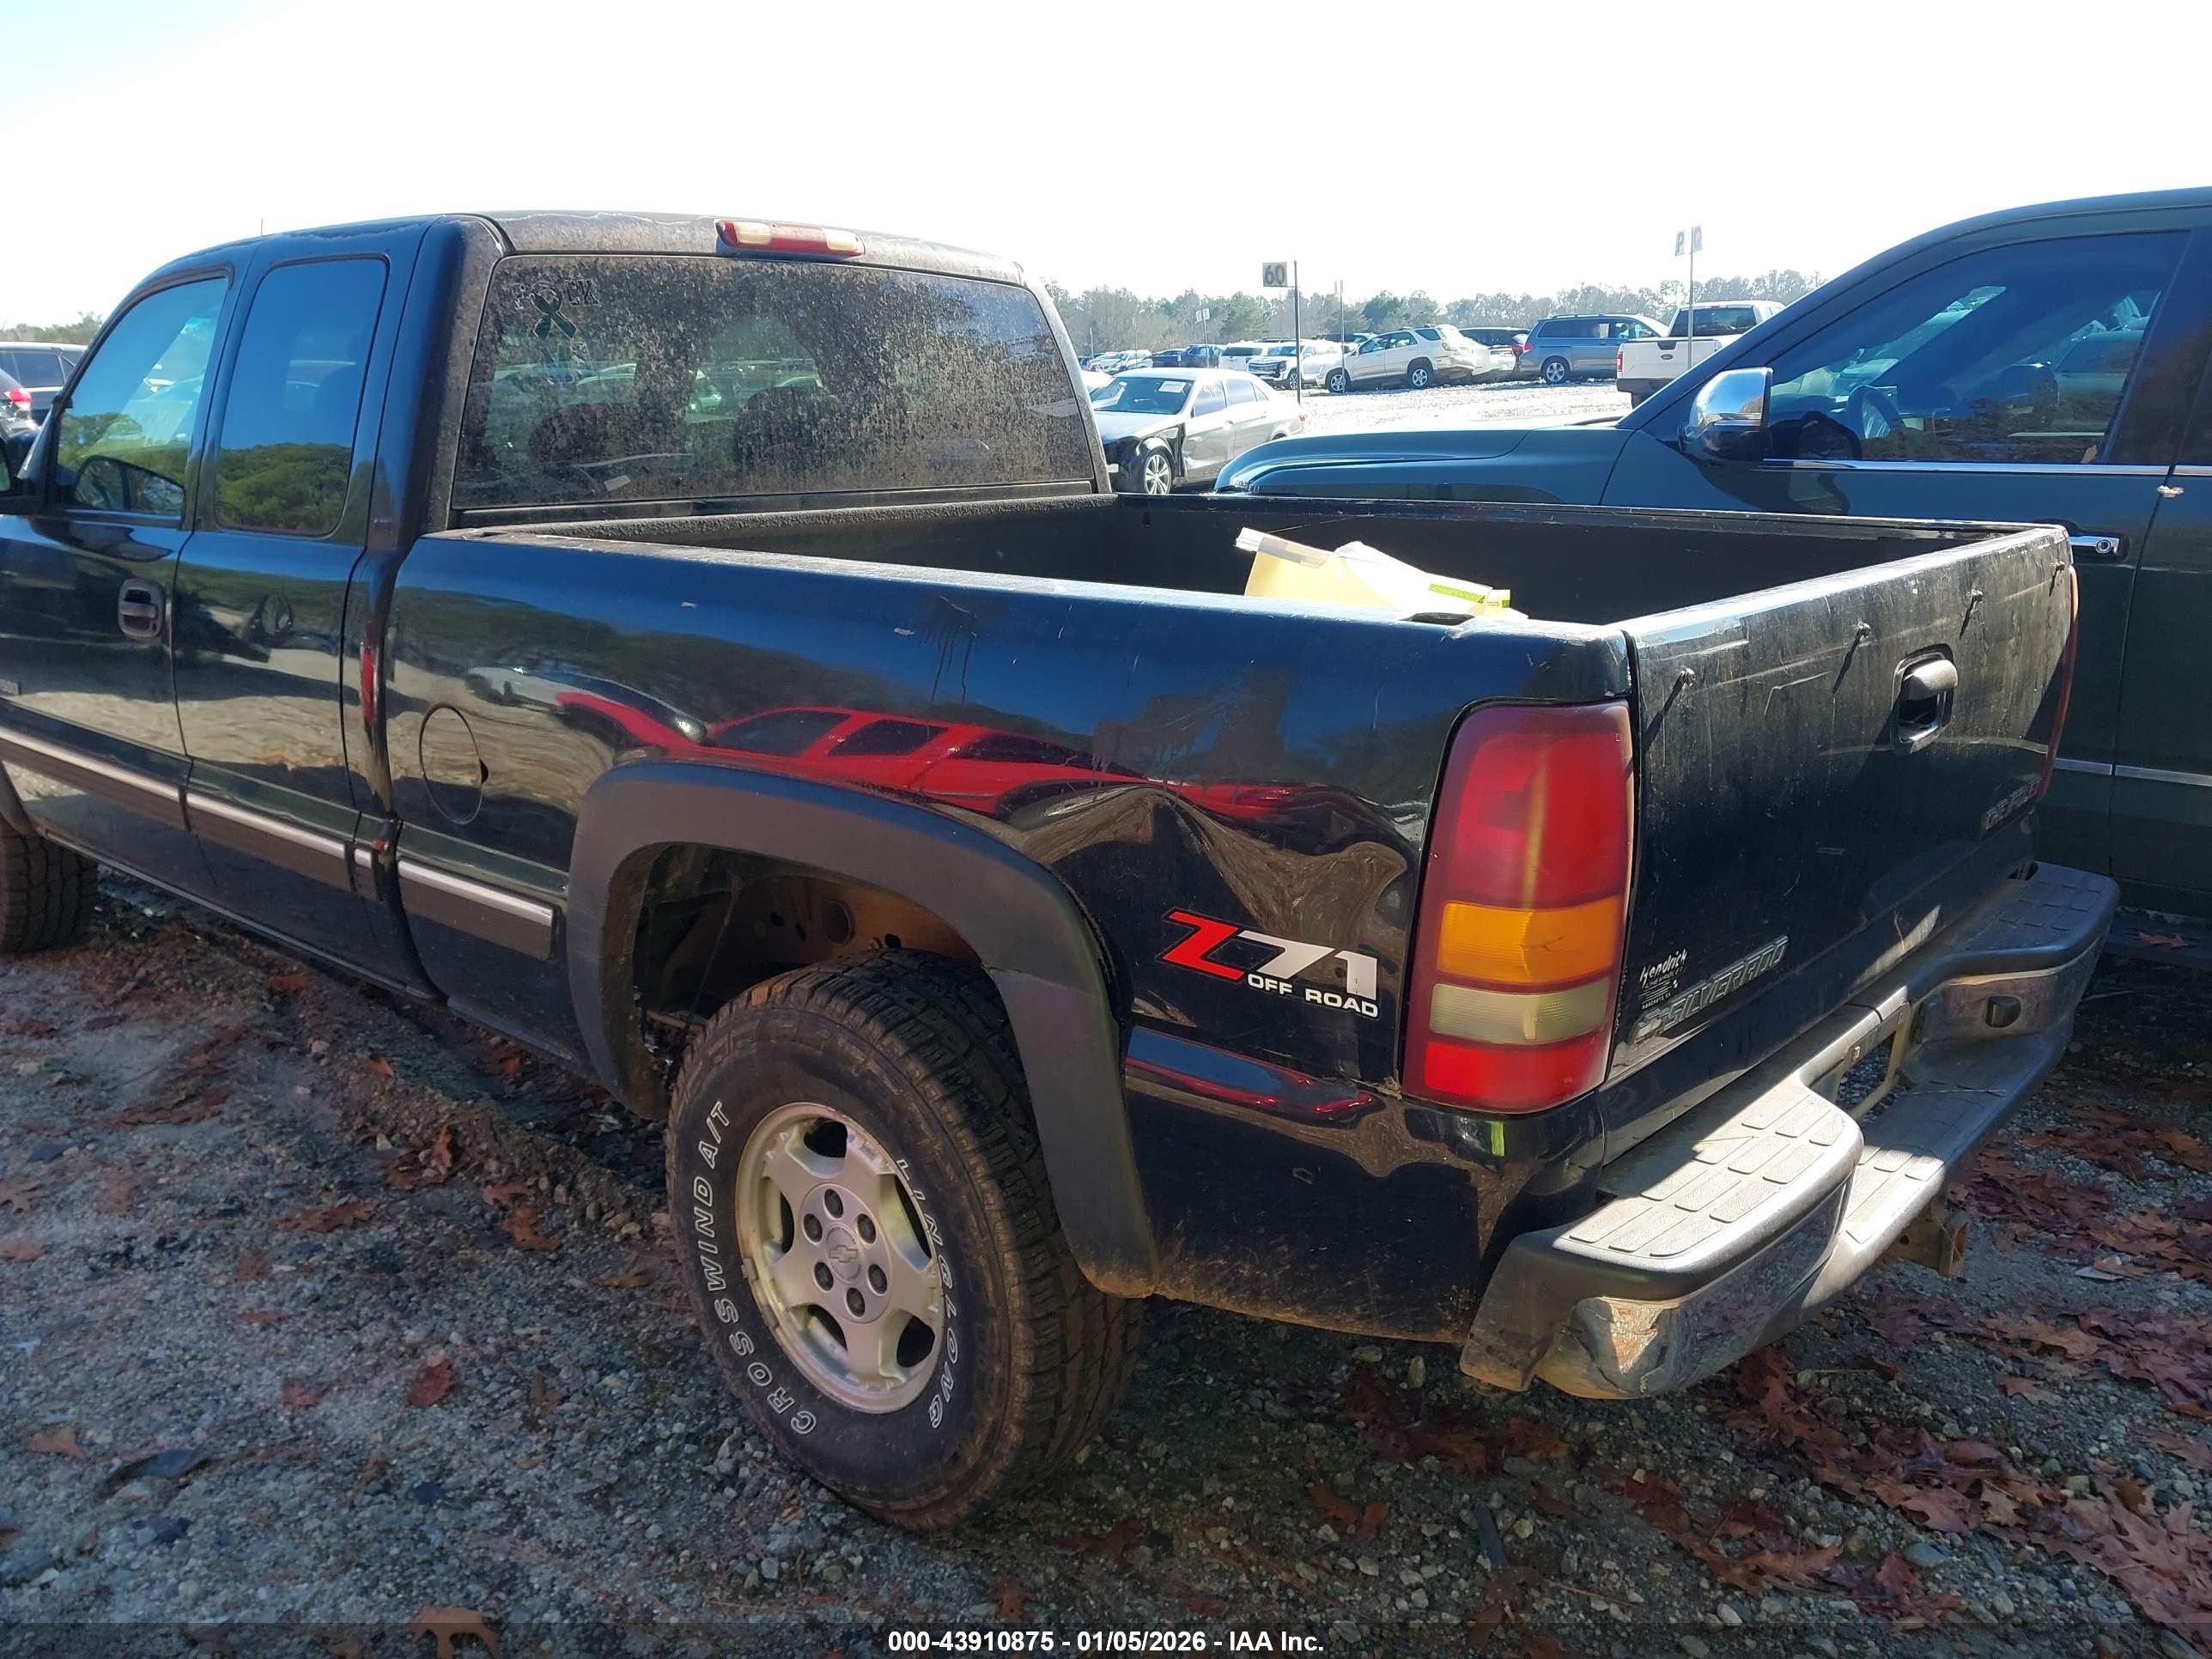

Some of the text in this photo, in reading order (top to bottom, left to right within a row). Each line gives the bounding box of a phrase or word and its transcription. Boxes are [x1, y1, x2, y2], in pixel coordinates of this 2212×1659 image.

[1264, 264, 1285, 285] 60
[1160, 910, 1378, 1000] Z71
[1639, 948, 1688, 988] Hendrick
[1662, 935, 1790, 1031] SILVERADO
[1248, 973, 1379, 1018] OFF ROAD
[693, 1100, 817, 1435] CROSSWIND A/T
